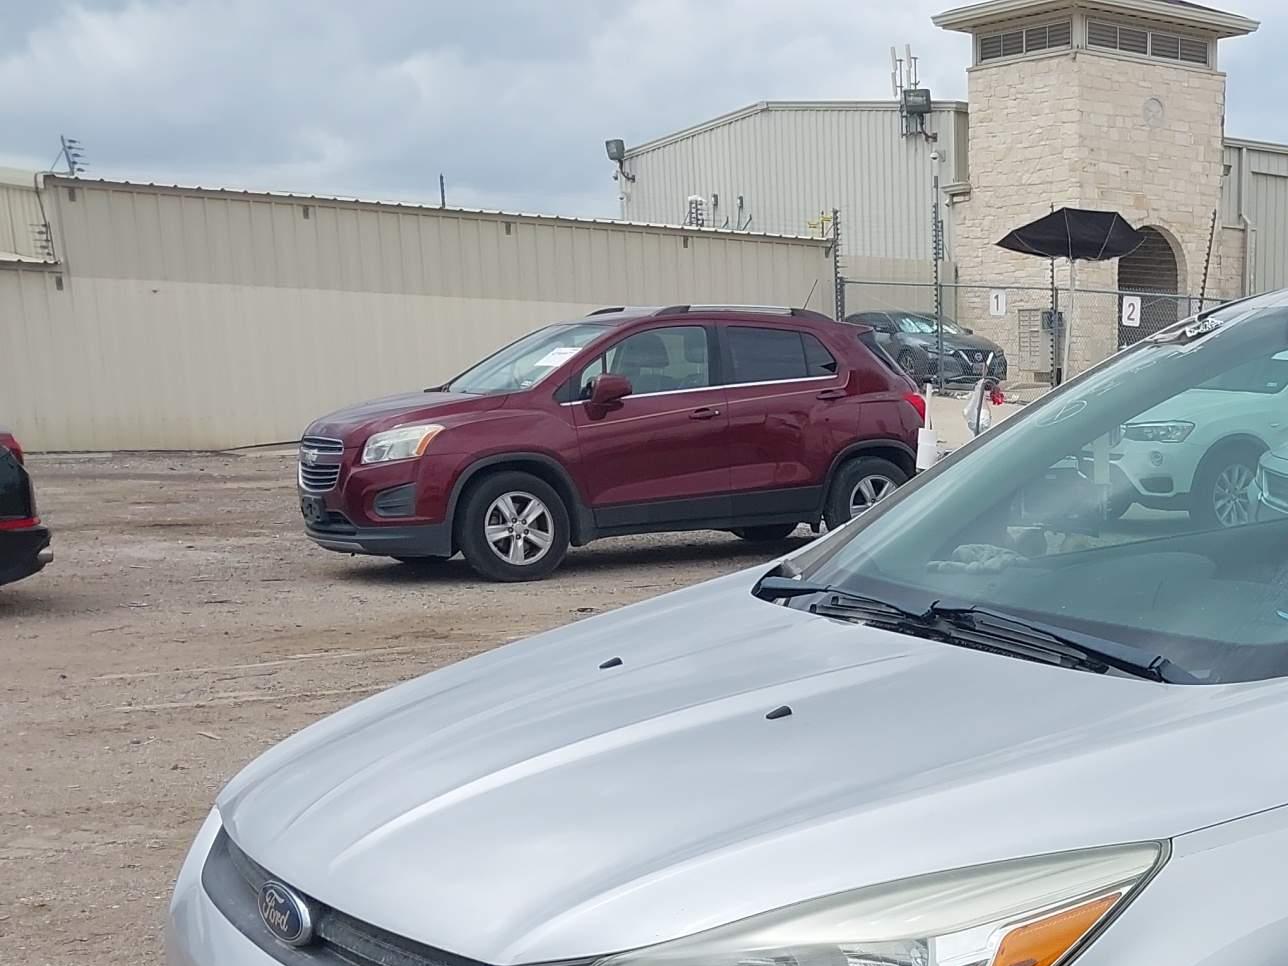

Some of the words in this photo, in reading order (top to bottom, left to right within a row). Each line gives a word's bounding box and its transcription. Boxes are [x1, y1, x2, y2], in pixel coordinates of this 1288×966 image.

[993, 293, 1000, 313] 1
[1127, 302, 1136, 321] 2
[262, 889, 290, 932] Ford
